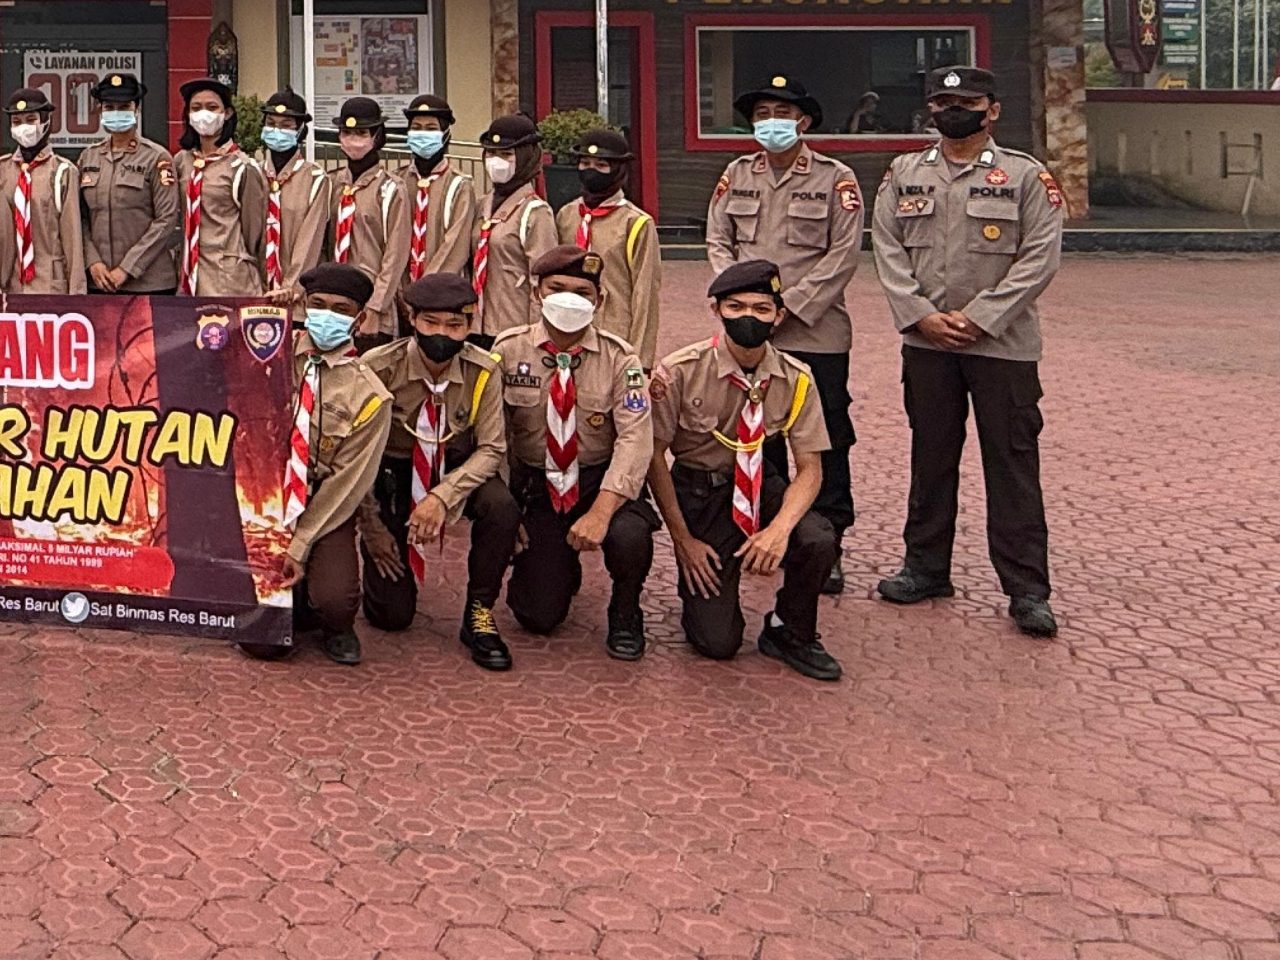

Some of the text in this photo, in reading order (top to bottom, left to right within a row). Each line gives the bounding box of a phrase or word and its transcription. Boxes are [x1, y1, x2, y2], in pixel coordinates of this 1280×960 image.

[44, 56, 136, 70] LAYANAN POLISI
[970, 187, 1014, 199] POLRI
[42, 406, 235, 468] HUTAN
[55, 544, 93, 556] MILYAR
[11, 553, 27, 563] NO
[42, 555, 78, 566] TAHUN
[24, 596, 59, 613] Barut
[90, 601, 236, 628] Sat Binmas Res Barut
